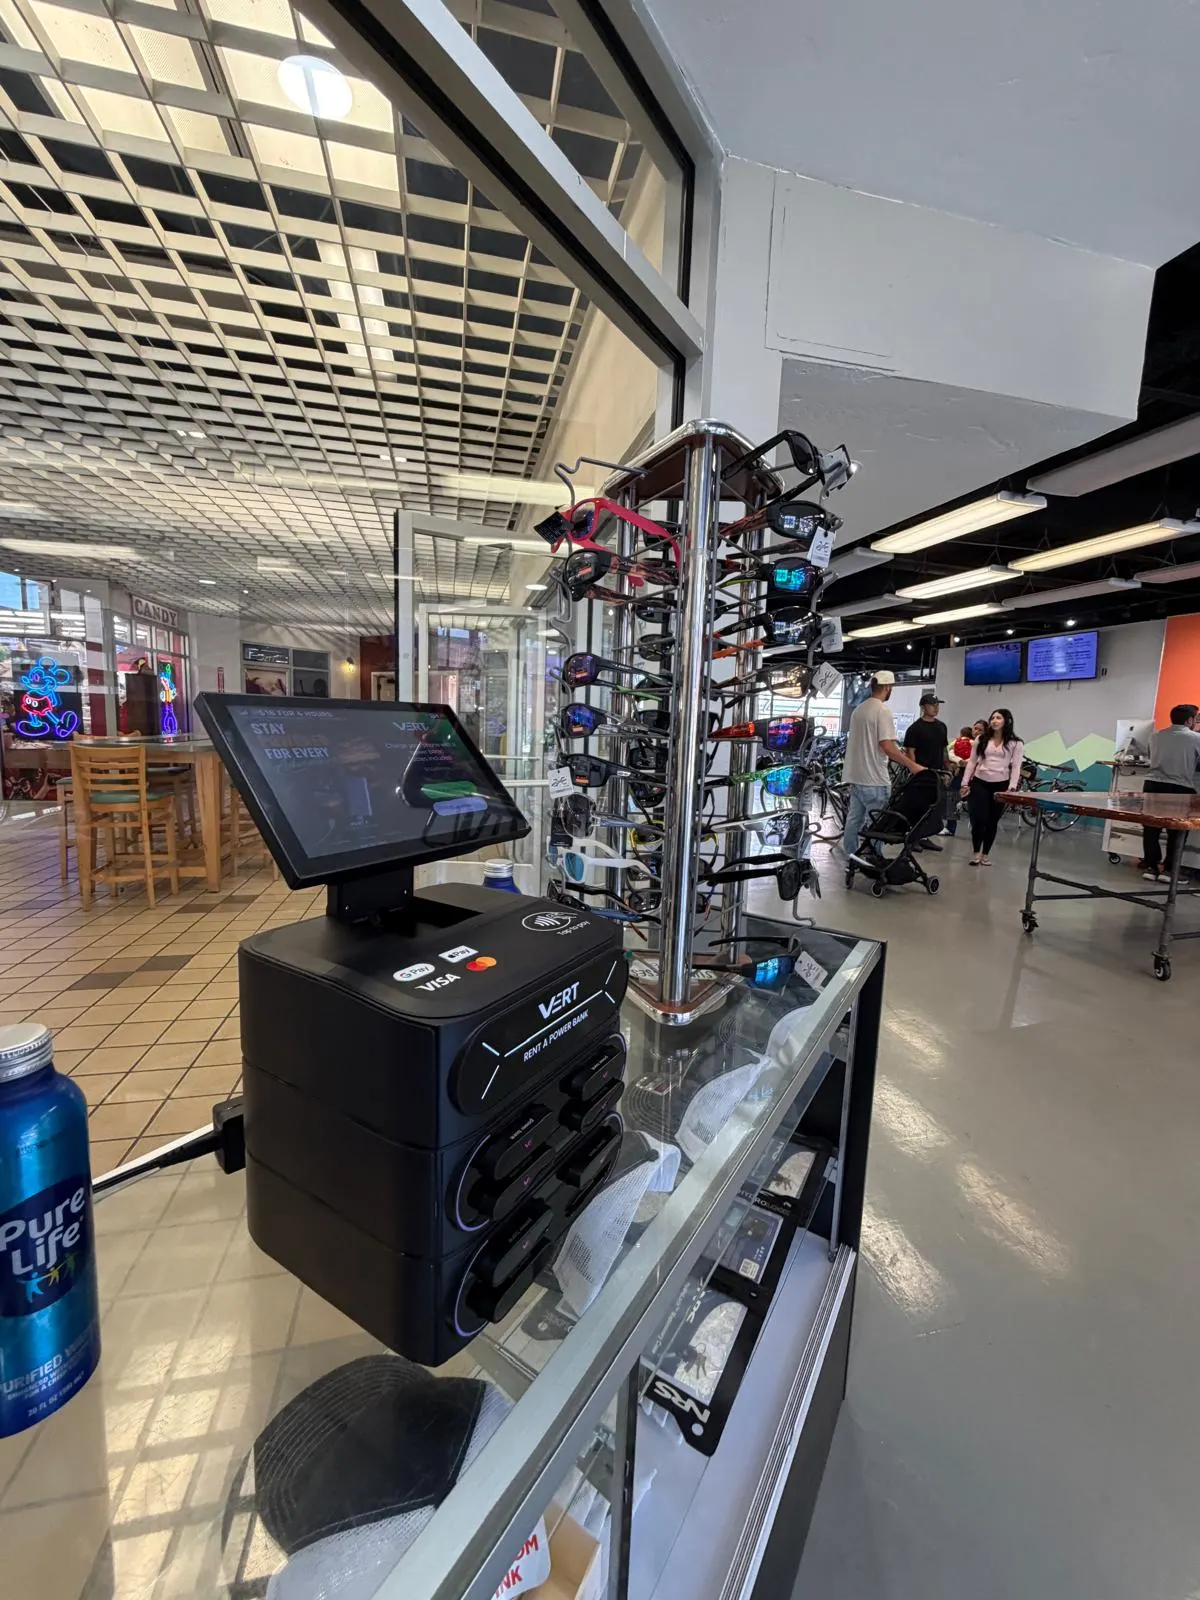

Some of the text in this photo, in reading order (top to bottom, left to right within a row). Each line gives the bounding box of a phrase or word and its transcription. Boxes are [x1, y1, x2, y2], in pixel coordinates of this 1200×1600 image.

[134, 600, 178, 626] CANDY
[251, 723, 285, 735] STAY
[264, 747, 329, 760] FOR EVERY
[455, 948, 471, 957] Pay
[410, 966, 430, 975] Pay
[414, 973, 462, 992] VISA
[538, 981, 580, 1020] VERT
[523, 1009, 589, 1062] RENT A POWER BANK
[0, 1186, 85, 1251] Pure
[11, 1221, 81, 1276] Life
[653, 1380, 711, 1424] NRS
